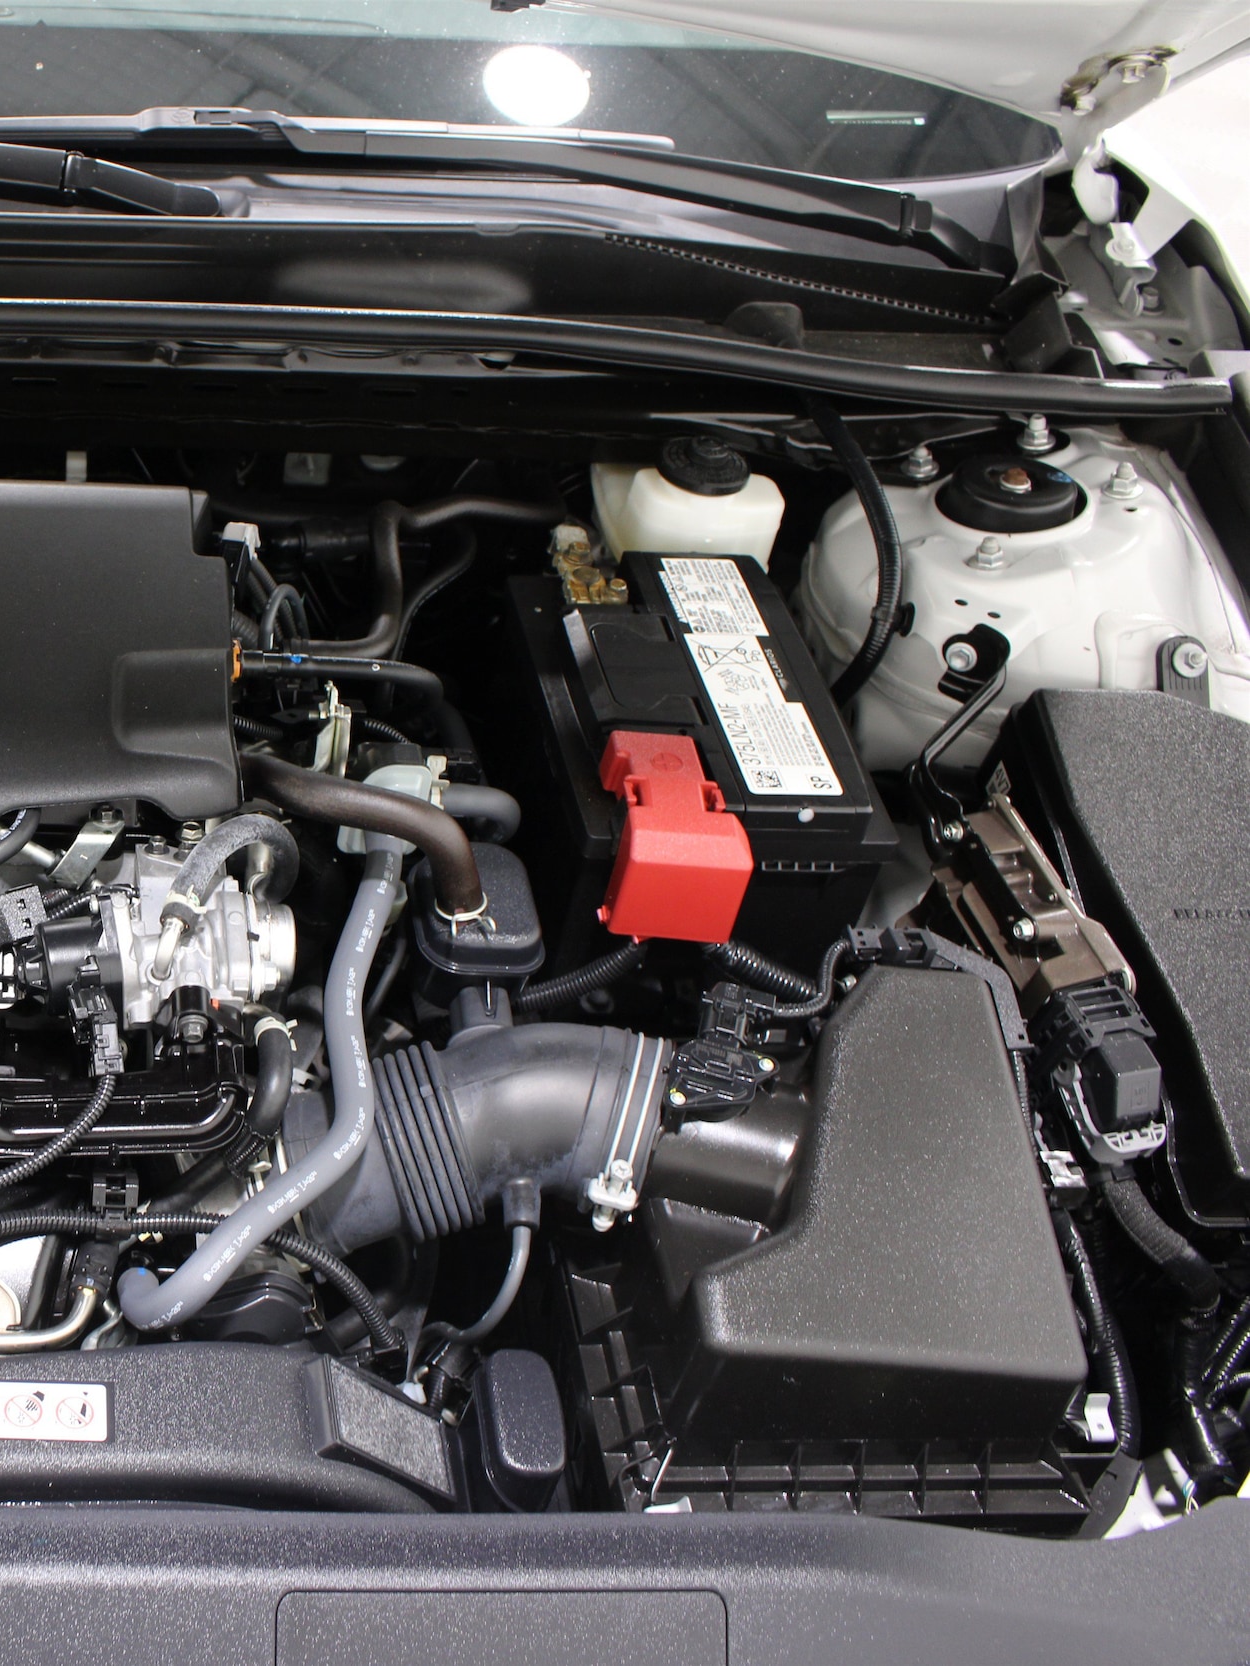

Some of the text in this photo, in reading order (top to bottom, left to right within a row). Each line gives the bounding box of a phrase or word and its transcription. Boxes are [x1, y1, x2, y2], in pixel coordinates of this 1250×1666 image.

[765, 648, 783, 677] CLARIOS
[718, 703, 761, 766] 375LN2-MF
[810, 776, 832, 789] SP
